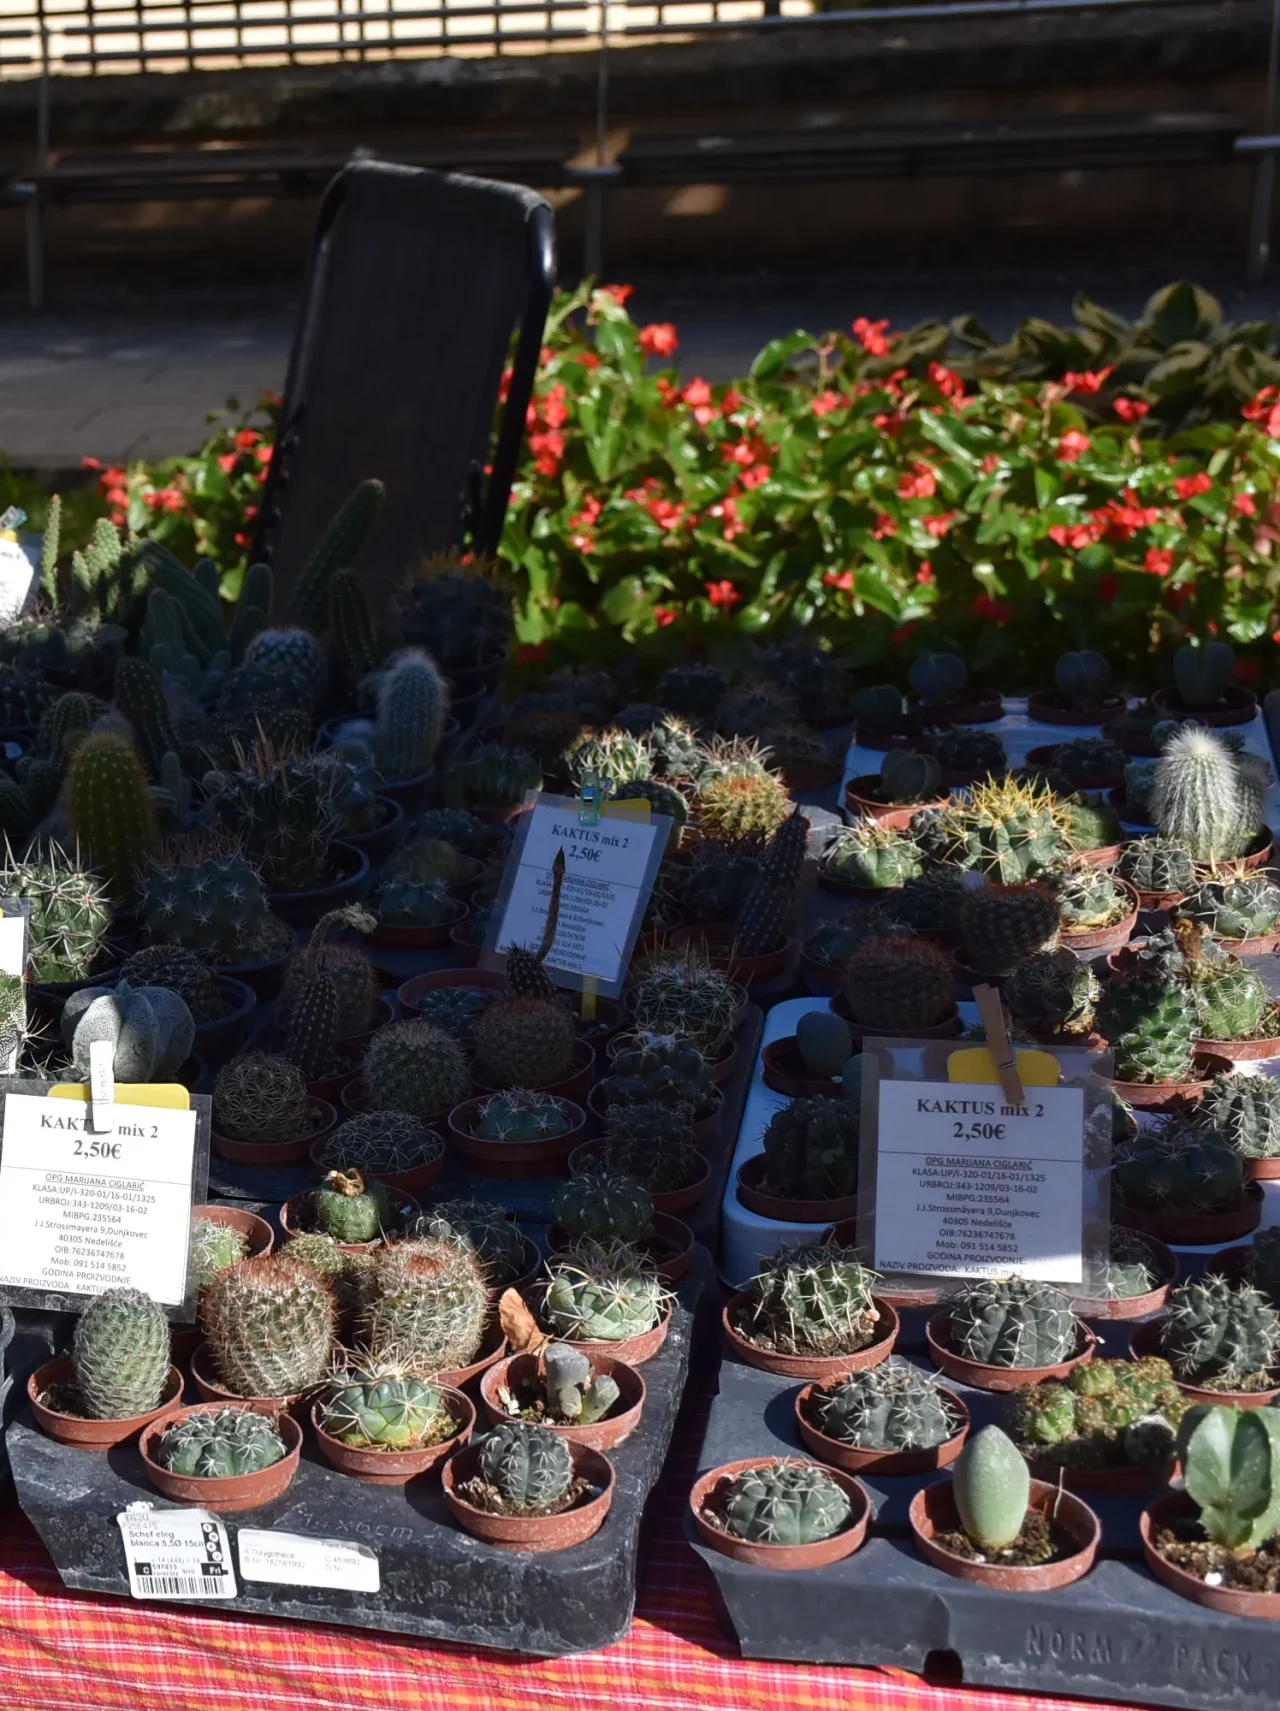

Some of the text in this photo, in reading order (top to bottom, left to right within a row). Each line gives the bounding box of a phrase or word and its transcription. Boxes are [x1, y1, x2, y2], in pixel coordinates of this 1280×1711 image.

[552, 824, 629, 848] KAKTUS mix 2
[569, 845, 602, 862] 2,50€
[917, 1099, 1044, 1117] KAKTUS mix 2
[41, 1115, 158, 1138] KAKT mix 2
[953, 1122, 1006, 1141] 2,50€
[73, 1140, 122, 1159] 2,50€
[925, 1156, 1032, 1171] OPG MARIJANA CIGLARIĆ
[45, 1174, 144, 1191] OPG MARIJANA CIGLARIĆ
[946, 1194, 1009, 1204] MIBPG:235564
[63, 1211, 121, 1223] MIBPG:235564
[942, 1217, 1012, 1229] 40305 Nedelišće
[59, 1235, 123, 1248] 40305 Nedelišće
[939, 1229, 1015, 1240] OIB:76236747678
[55, 1245, 125, 1260] OIB:76236747678
[936, 1240, 1018, 1252] Mob: 091 514 5852
[51, 1257, 126, 1272] Mob: 091 514 5852
[927, 1252, 1027, 1265] GODINA PROIZVODNJE:
[880, 1260, 905, 1269] NAZIV
[907, 1262, 960, 1273] PROIZVODA:
[965, 1266, 999, 1276] KAKTUS
[23, 1277, 71, 1290] PROIZVODA:
[42, 1268, 134, 1285] GODINA PROIZVODNJE:
